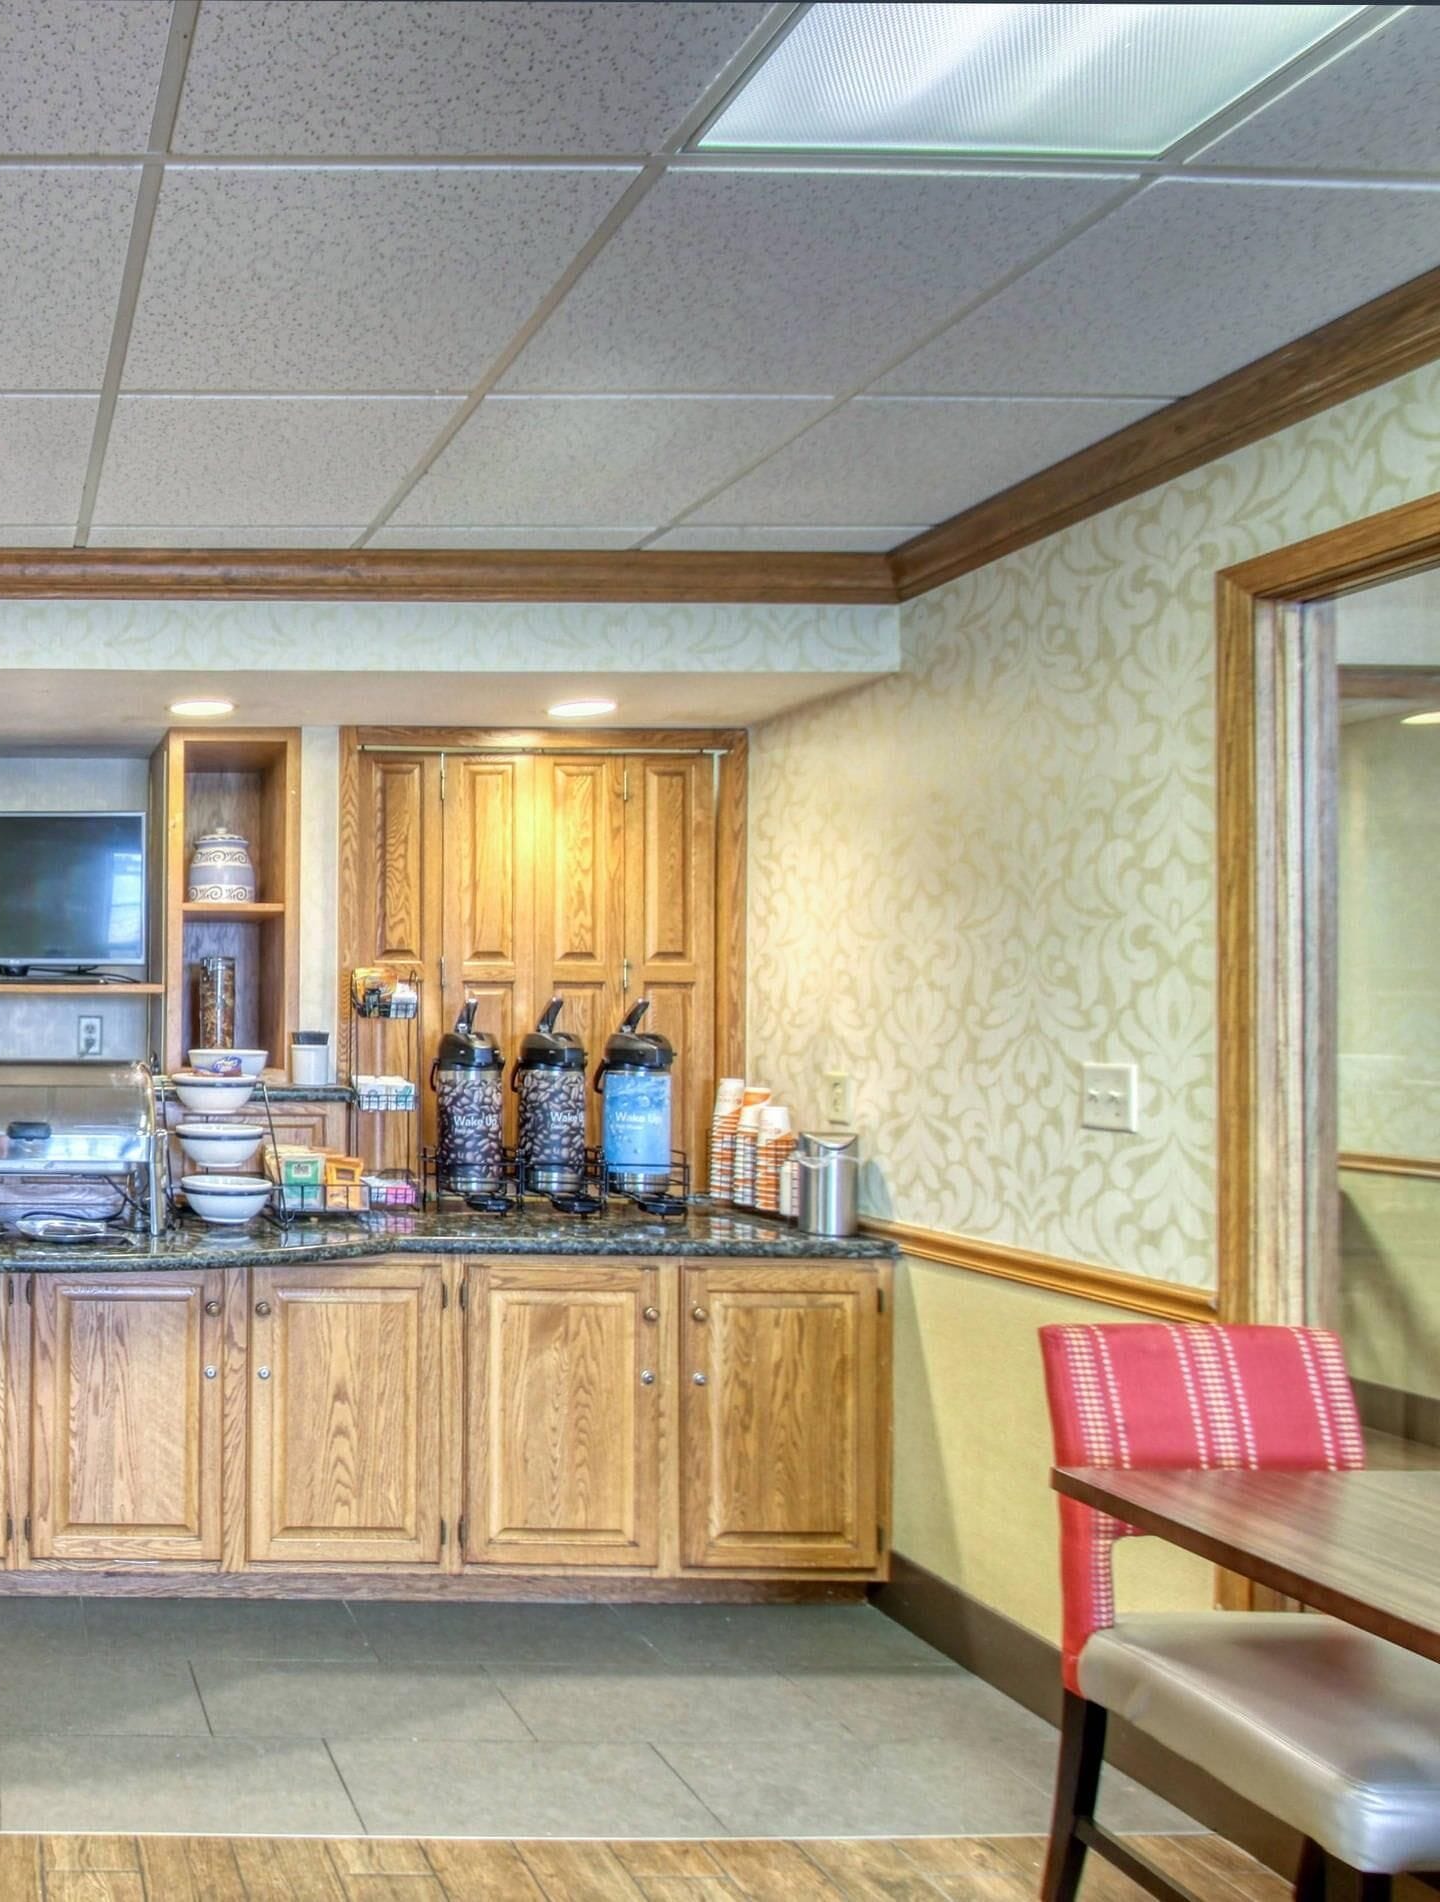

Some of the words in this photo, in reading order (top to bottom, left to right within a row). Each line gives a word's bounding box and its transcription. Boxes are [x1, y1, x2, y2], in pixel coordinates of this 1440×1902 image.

[453, 1114, 483, 1127] Wake
[485, 1113, 498, 1128] Up
[550, 1111, 578, 1123] Wake
[614, 1111, 645, 1122] Wake
